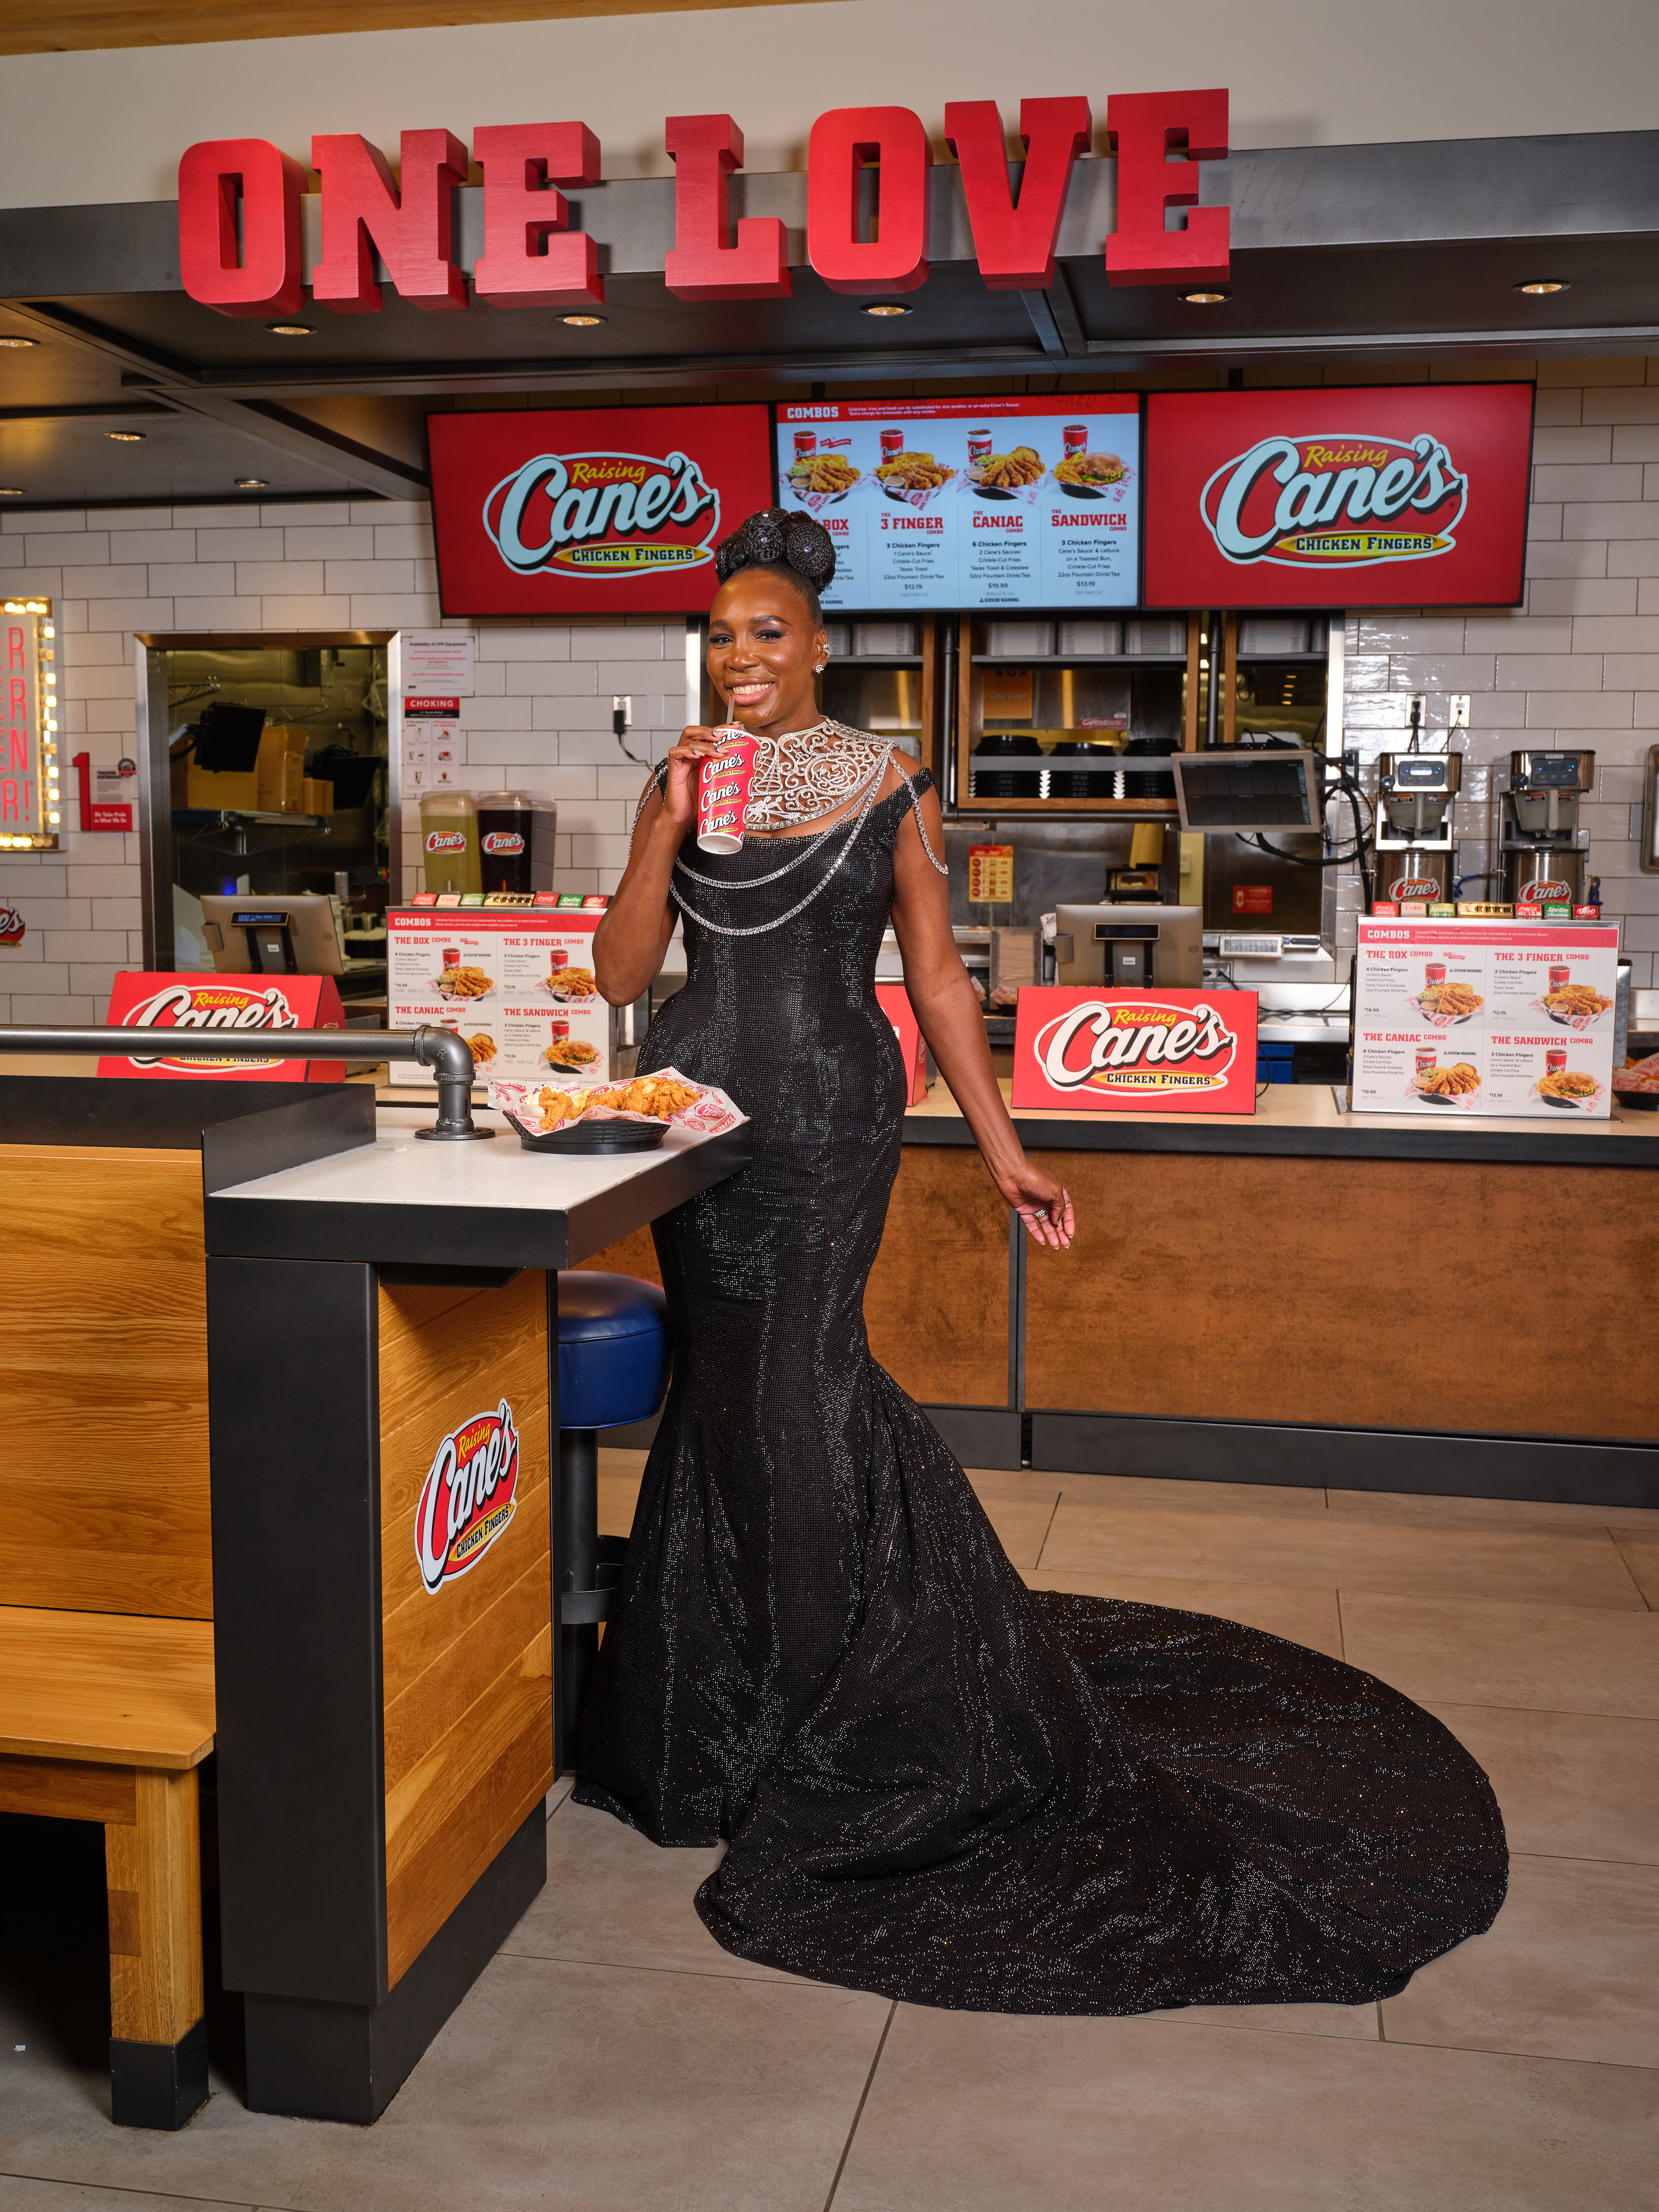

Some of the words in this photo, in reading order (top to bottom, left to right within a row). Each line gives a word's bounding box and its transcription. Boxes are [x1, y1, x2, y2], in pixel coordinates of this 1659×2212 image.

[179, 120, 605, 314] ONE
[665, 88, 1231, 300] LOVE
[787, 406, 839, 419] COMBOS
[1304, 444, 1388, 468] Raising
[572, 461, 646, 483] Raising
[1216, 439, 1463, 559] Cane's
[499, 456, 715, 570] Cane's
[973, 516, 1023, 527] CANIAC
[1052, 514, 1127, 526] SANDWICH
[823, 519, 849, 530] BOX
[881, 519, 888, 529] 3
[893, 518, 943, 529] FINGER
[1296, 537, 1361, 551] CHICKEN
[1367, 537, 1432, 550] FINGERS
[572, 550, 630, 562] CHICKEN
[635, 548, 693, 561] FINGERS
[703, 753, 745, 784] Cane's
[701, 781, 742, 812] Cane's
[699, 810, 738, 836] Cane's
[427, 832, 464, 852] Cane's
[484, 833, 524, 852] Cane's
[1391, 878, 1439, 901] Cane's
[1520, 881, 1571, 903] Cane's
[1367, 930, 1410, 939] COMBOS
[1518, 953, 1523, 961] 3
[1526, 953, 1563, 961] FINGER
[193, 992, 249, 1009] Raising
[524, 1008, 569, 1017] SANDWICH
[1113, 1009, 1178, 1027] Raising
[1046, 1004, 1234, 1087] Cane's
[1386, 1034, 1421, 1042] CANIAC
[1491, 1036, 1511, 1044] THE
[1514, 1036, 1567, 1045] SANDWICH
[1107, 1073, 1156, 1084] CHICKEN
[1161, 1074, 1211, 1085] FINGERS
[695, 1102, 726, 1117] Cane's
[458, 1423, 491, 1463] Raising
[422, 1403, 517, 1589] Cane's
[457, 1526, 483, 1559] CHICKEN
[484, 1506, 509, 1535] FINGERS
